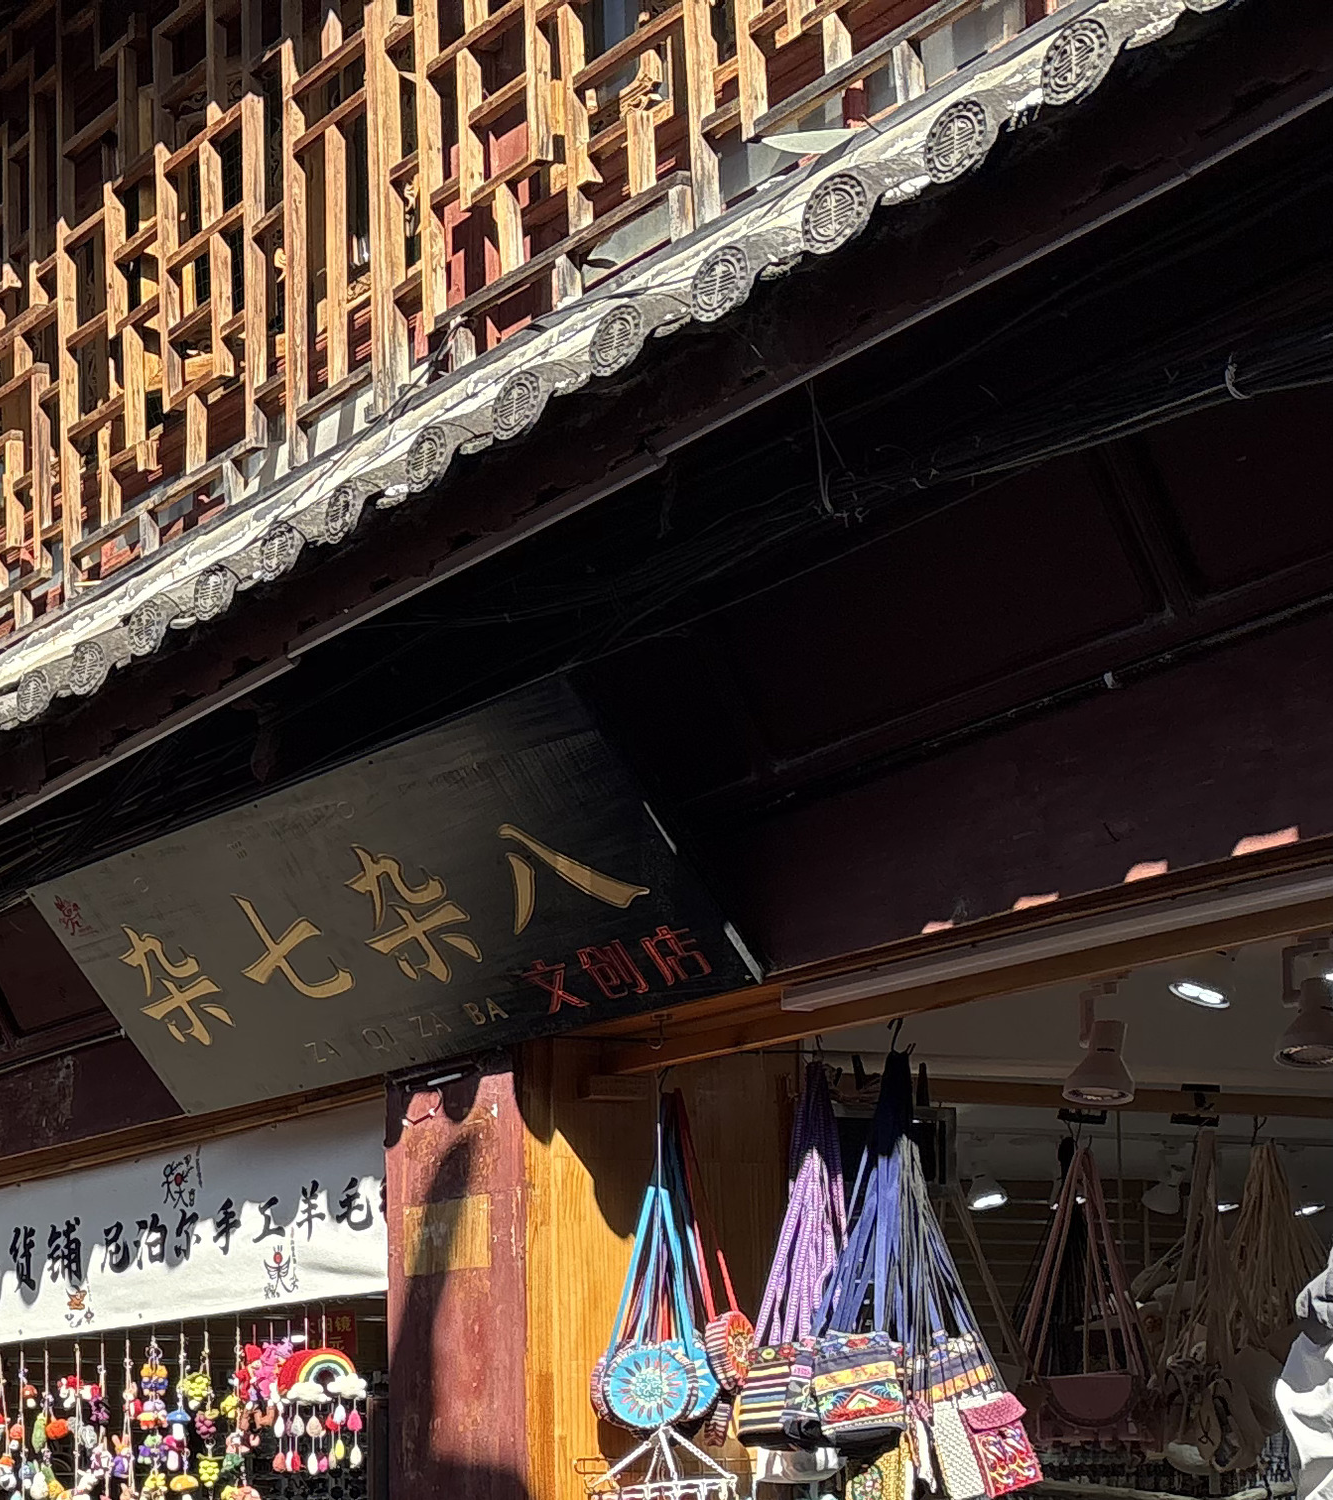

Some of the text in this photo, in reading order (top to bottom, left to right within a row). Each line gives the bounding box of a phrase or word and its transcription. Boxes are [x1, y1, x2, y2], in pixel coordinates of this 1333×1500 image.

[117, 823, 651, 1046] 杂七杂八
[522, 923, 713, 1017] 文创店
[303, 999, 511, 1065] ZA QI ZA BA
[101, 1176, 387, 1274] 尼泊尔手工羊毛
